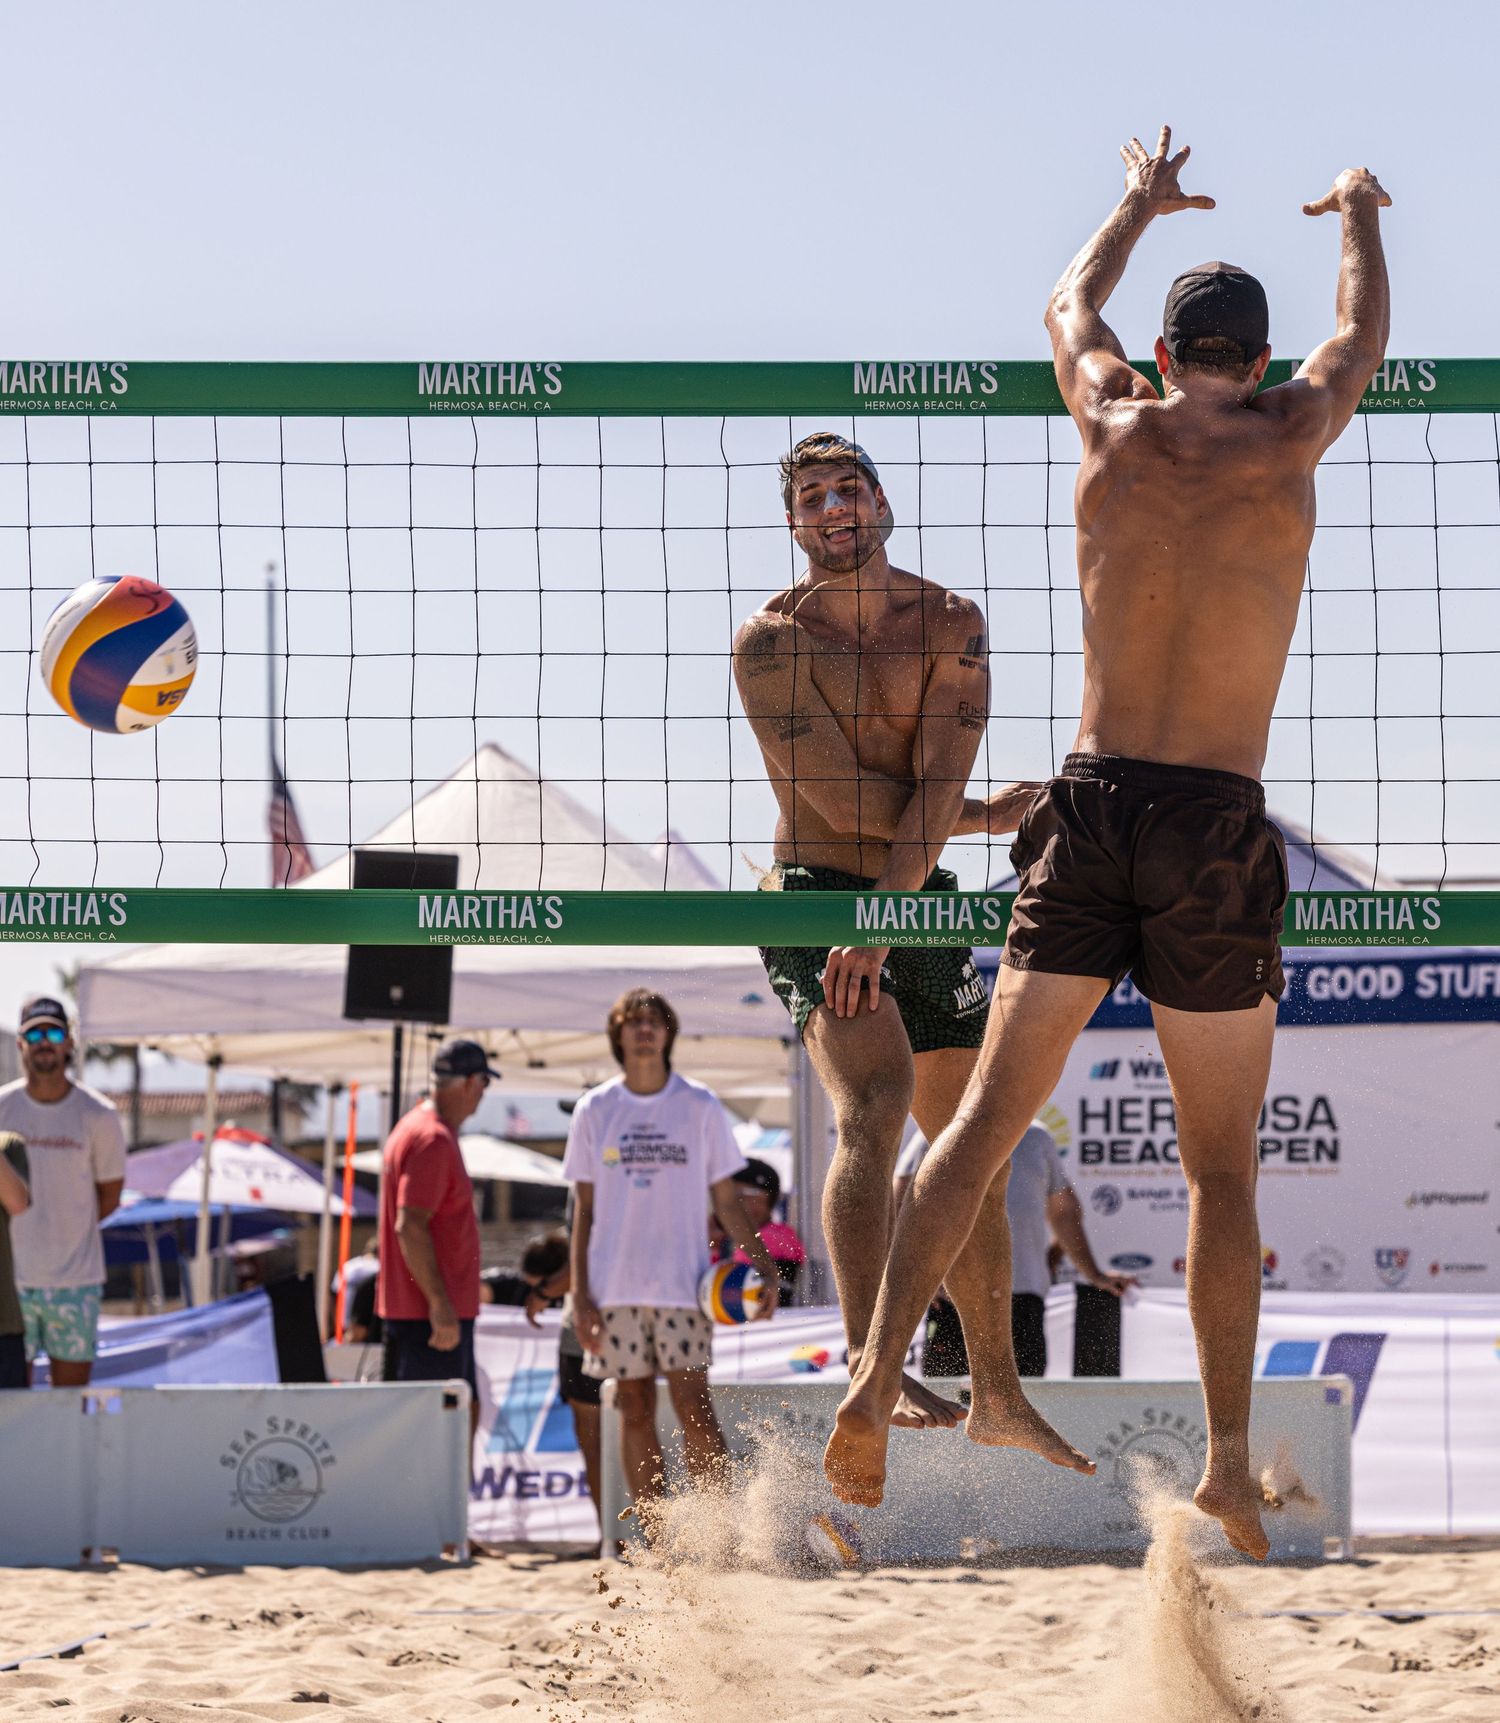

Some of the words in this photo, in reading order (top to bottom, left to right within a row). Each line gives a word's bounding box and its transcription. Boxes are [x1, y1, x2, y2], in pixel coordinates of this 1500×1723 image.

[418, 362, 563, 395] MARTHA'S
[854, 362, 998, 395] MARTHA'S
[55, 401, 96, 411] BEACH,
[100, 401, 118, 410] CA
[429, 401, 484, 411] HERMOSA
[488, 401, 530, 412] BEACH,
[534, 401, 551, 411] CA
[865, 401, 920, 410] HERMOSA
[924, 401, 966, 411] BEACH,
[970, 401, 987, 410] CA
[1362, 398, 1403, 408] BEACH,
[1408, 398, 1426, 408] CA
[0, 892, 127, 926] ARTHA'S
[418, 895, 563, 929] MARTHA'S
[856, 897, 1001, 931] MARTHA'S
[1295, 897, 1440, 931] MARTHA'S
[53, 931, 95, 941] BEACH,
[98, 932, 116, 941] CA
[429, 935, 486, 944] HERMOSA
[489, 935, 531, 945] BEACH,
[535, 935, 553, 944] CA
[867, 936, 922, 945] HERMOSA
[927, 936, 968, 946] BEACH,
[972, 936, 990, 945] CA
[1306, 936, 1361, 945] HERMOSA
[1365, 936, 1408, 946] BEACH,
[1412, 936, 1430, 945] CA
[1306, 964, 1403, 1001] GOOD
[1079, 1096, 1338, 1135] HERSA
[1258, 1138, 1339, 1164] PEN
[219, 1429, 258, 1470] SEA
[267, 1415, 337, 1470] SPRITE
[225, 1527, 282, 1541] BEACH
[287, 1527, 331, 1541] CLUB
